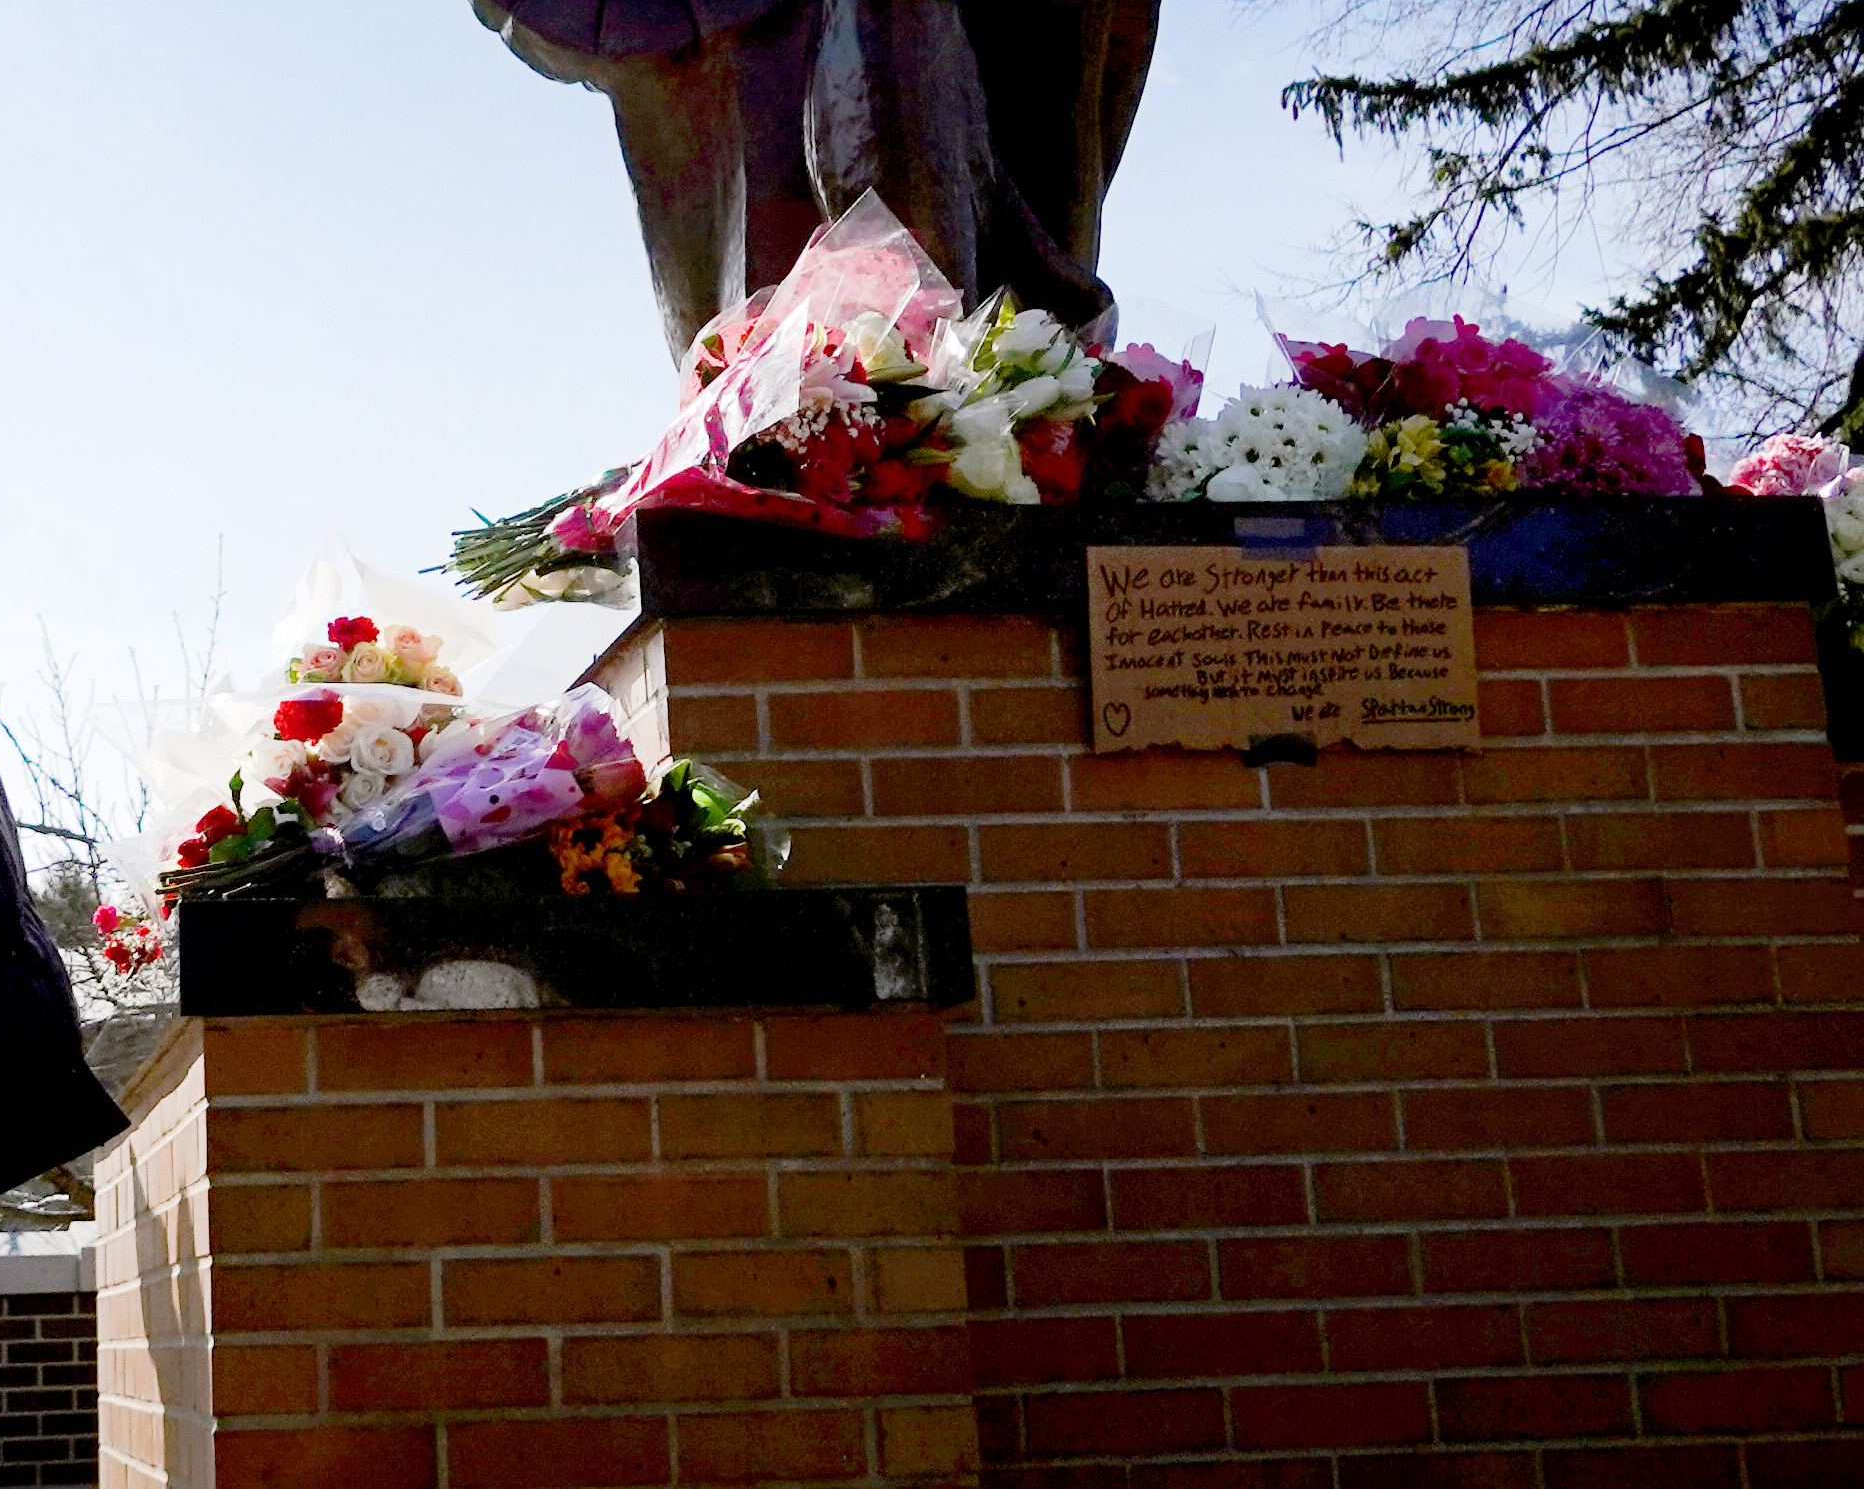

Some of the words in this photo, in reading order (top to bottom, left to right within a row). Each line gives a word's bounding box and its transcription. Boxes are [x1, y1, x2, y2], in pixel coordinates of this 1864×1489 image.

[1100, 564, 1149, 598] We
[1159, 568, 1196, 588] are
[1307, 562, 1347, 582] than
[1353, 562, 1389, 582] this
[1393, 567, 1438, 583] act
[1257, 595, 1290, 611] are
[1371, 593, 1400, 612] Be
[1406, 592, 1457, 610] there
[1247, 620, 1290, 641] Rest
[1295, 625, 1314, 638] in
[1376, 620, 1397, 634] to
[1402, 618, 1446, 635] those
[1433, 646, 1452, 660] us
[1364, 666, 1382, 682] us
